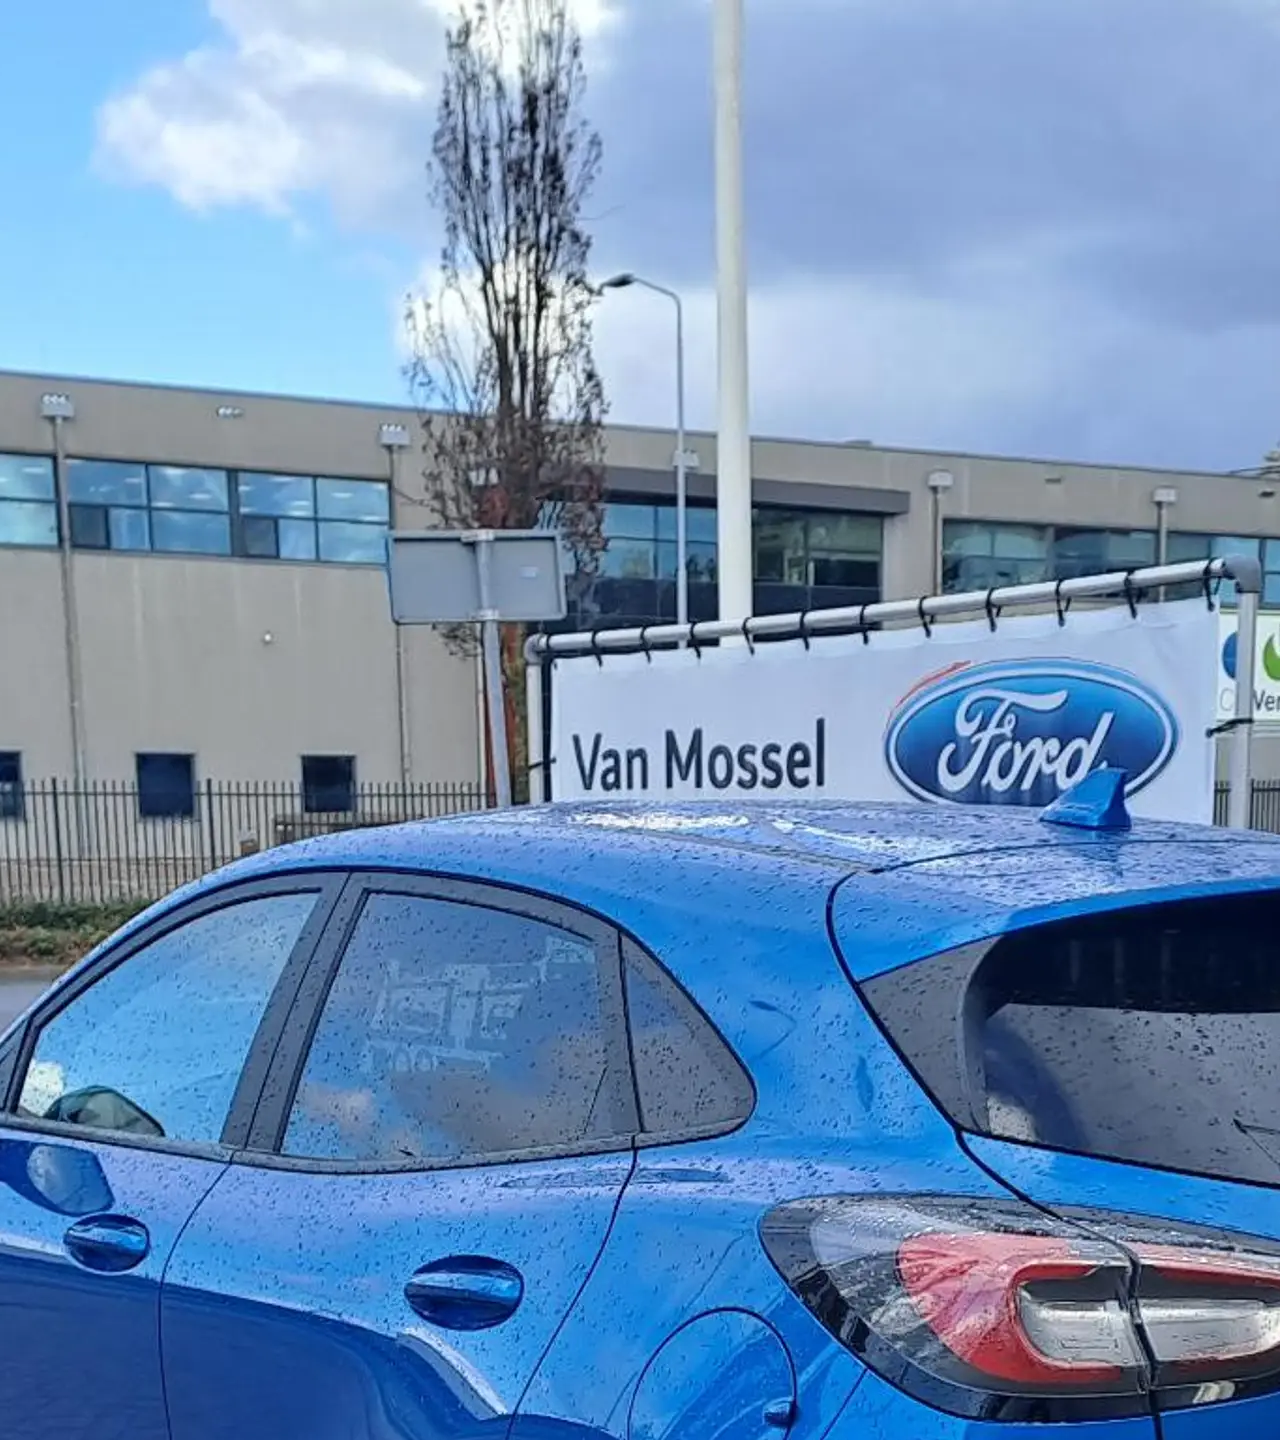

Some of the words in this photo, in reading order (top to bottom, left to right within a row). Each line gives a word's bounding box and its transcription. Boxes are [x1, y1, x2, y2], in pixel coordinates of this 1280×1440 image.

[572, 733, 649, 791] Van
[665, 717, 826, 790] Mossel
[937, 688, 1117, 793] Ford
